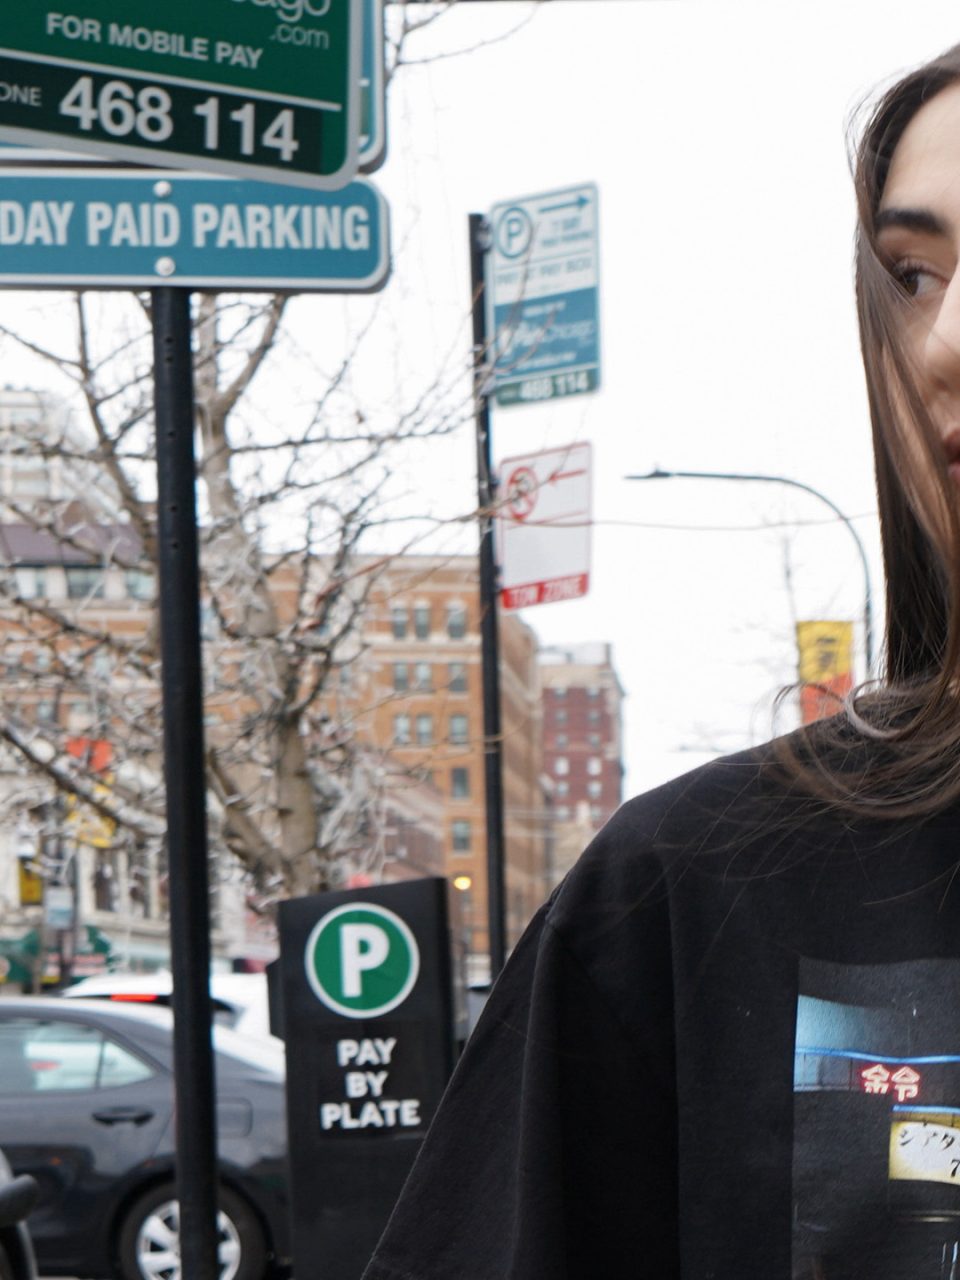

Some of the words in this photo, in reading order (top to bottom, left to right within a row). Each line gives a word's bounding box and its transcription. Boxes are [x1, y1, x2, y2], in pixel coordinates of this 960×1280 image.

[46, 12, 101, 42] FOR
[109, 24, 208, 61] MOBILE
[215, 43, 264, 69] PAY
[269, 23, 330, 50] .com
[59, 76, 173, 142] 468
[194, 97, 299, 161] 114
[0, 201, 74, 246] DAY
[86, 202, 181, 247] PAID
[193, 204, 370, 250] PARKING
[544, 576, 582, 603] ZONE
[341, 922, 390, 997] P
[337, 1037, 397, 1067] PAY
[345, 1071, 389, 1098] BY
[320, 1099, 421, 1130] PLATE
